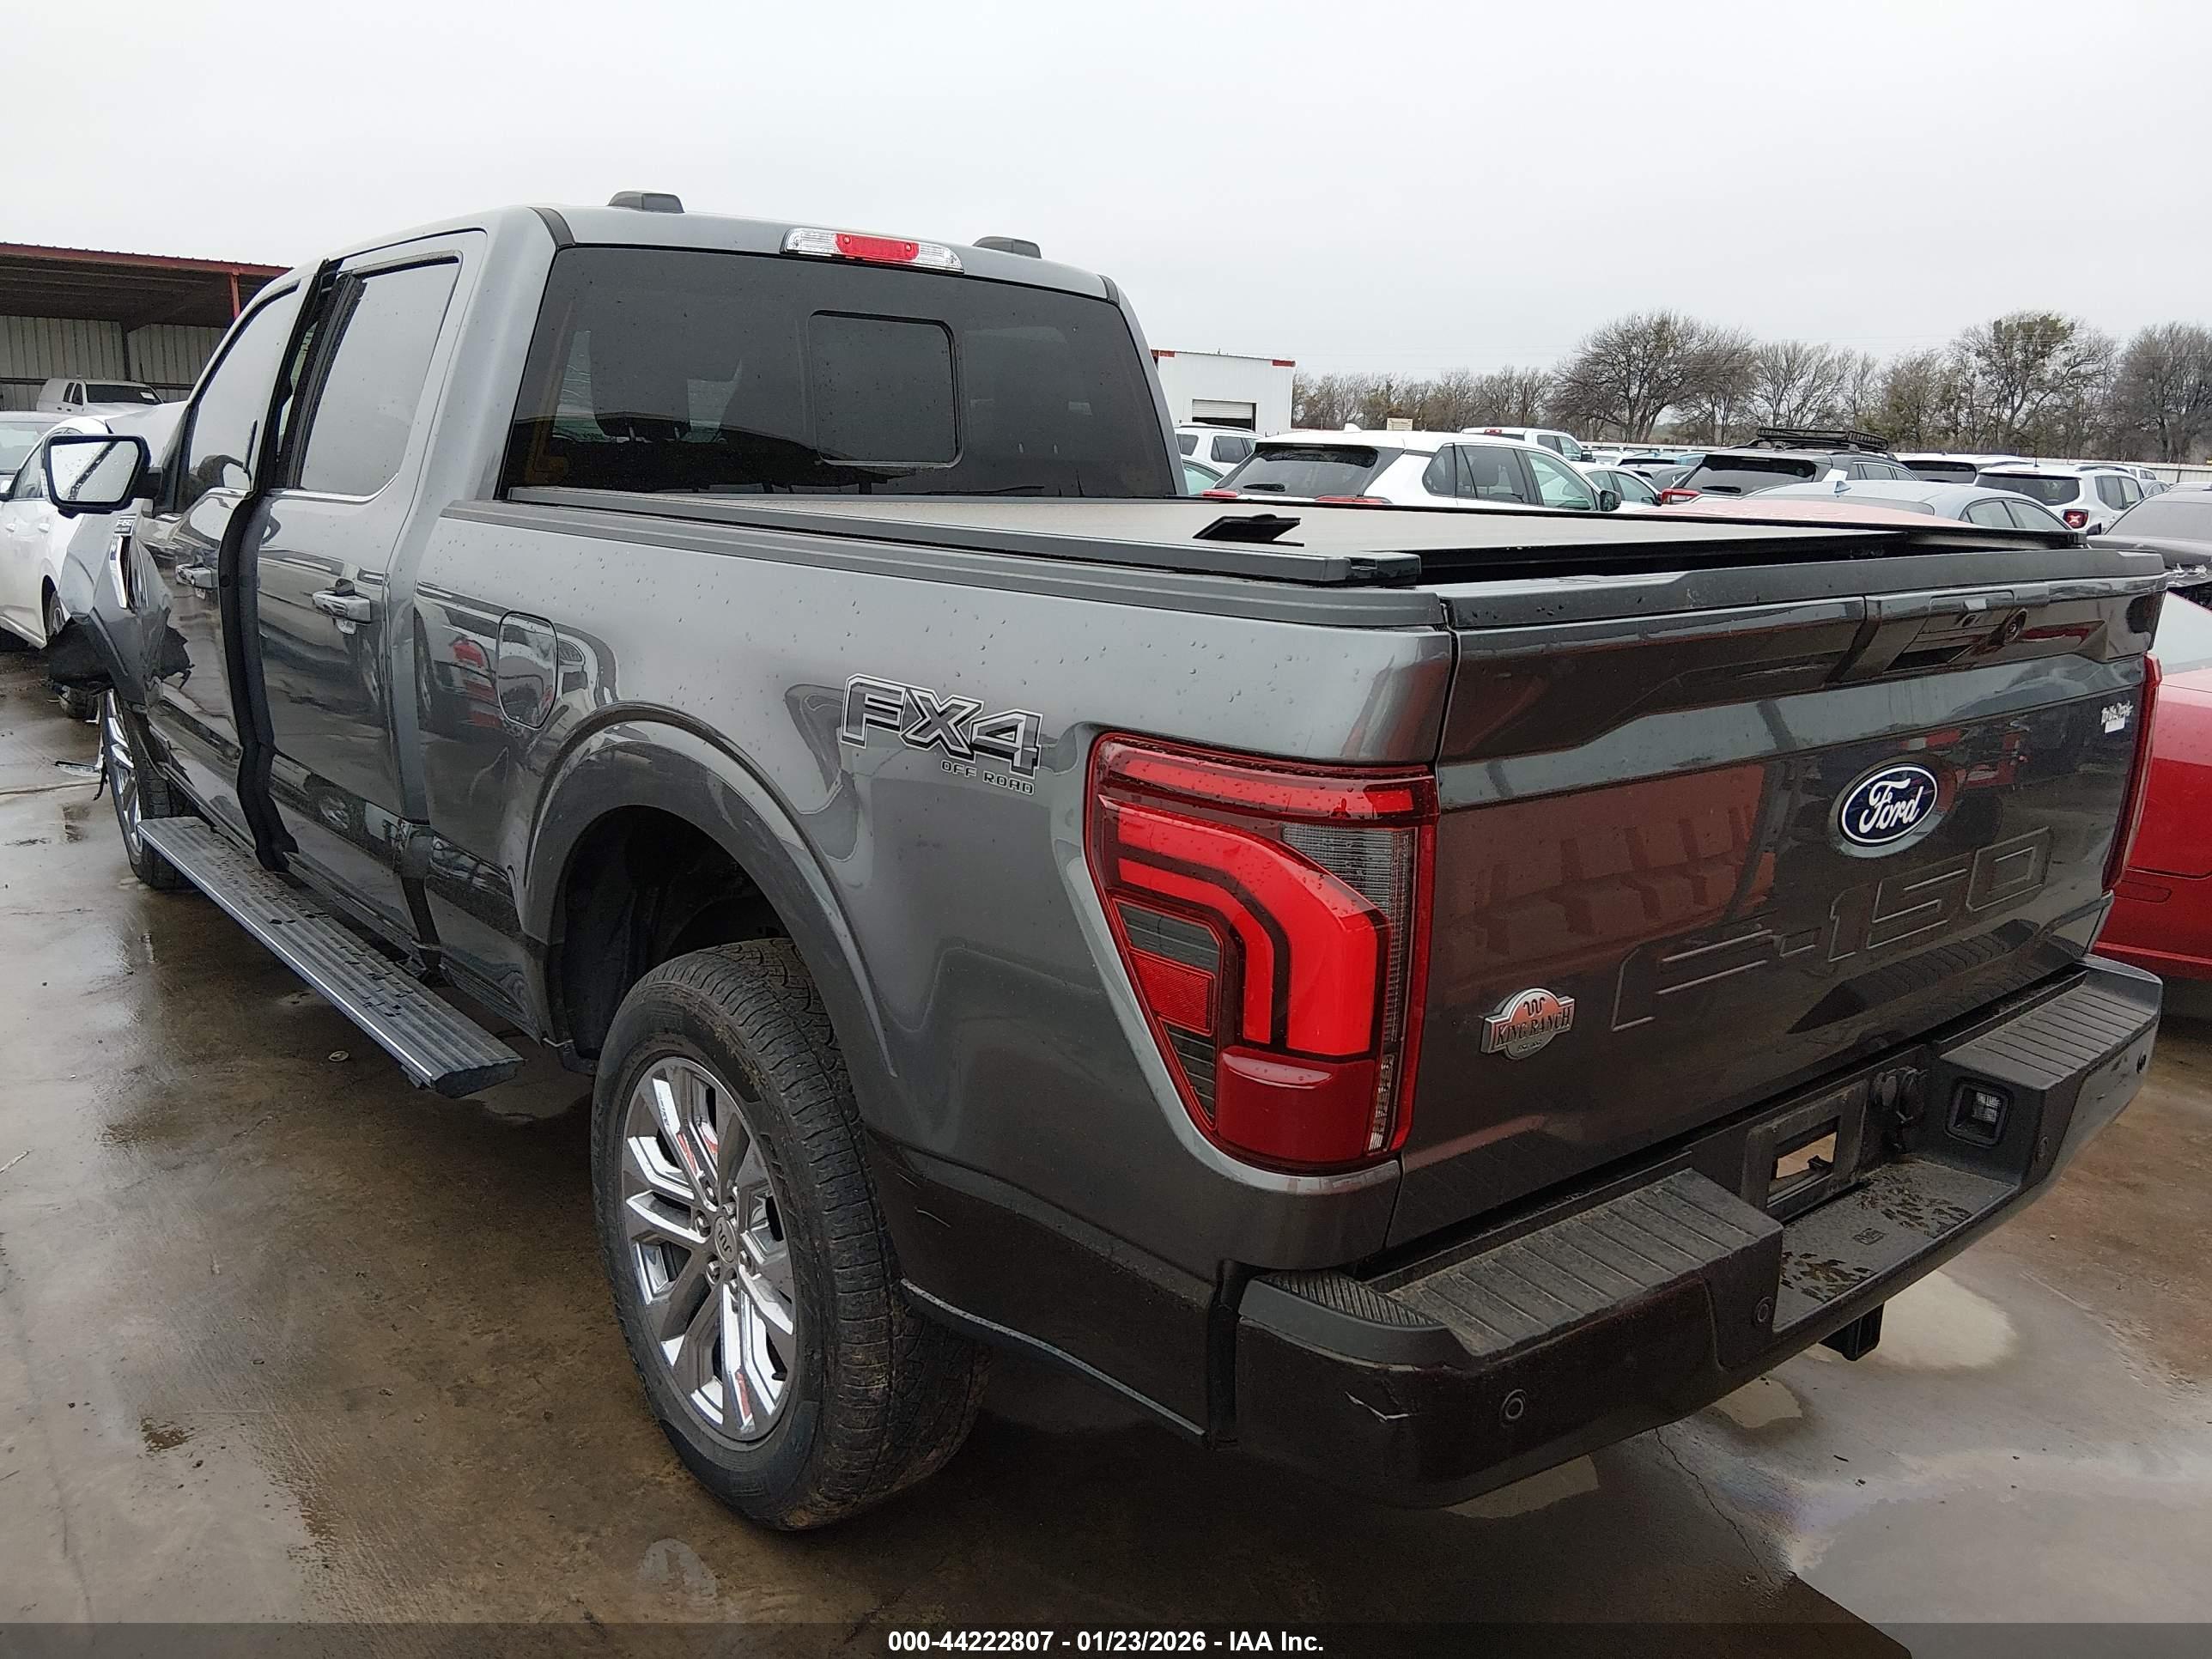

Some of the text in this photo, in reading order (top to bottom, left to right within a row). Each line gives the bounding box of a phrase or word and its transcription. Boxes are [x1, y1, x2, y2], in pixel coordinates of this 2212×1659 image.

[840, 672, 1043, 779] FX4
[940, 759, 1035, 795] OFF ROAD
[1858, 777, 1924, 834] Ford
[1611, 826, 2054, 1031] F-150
[1496, 1021, 1528, 1046] KING
[1530, 1006, 1571, 1036] RANCH
